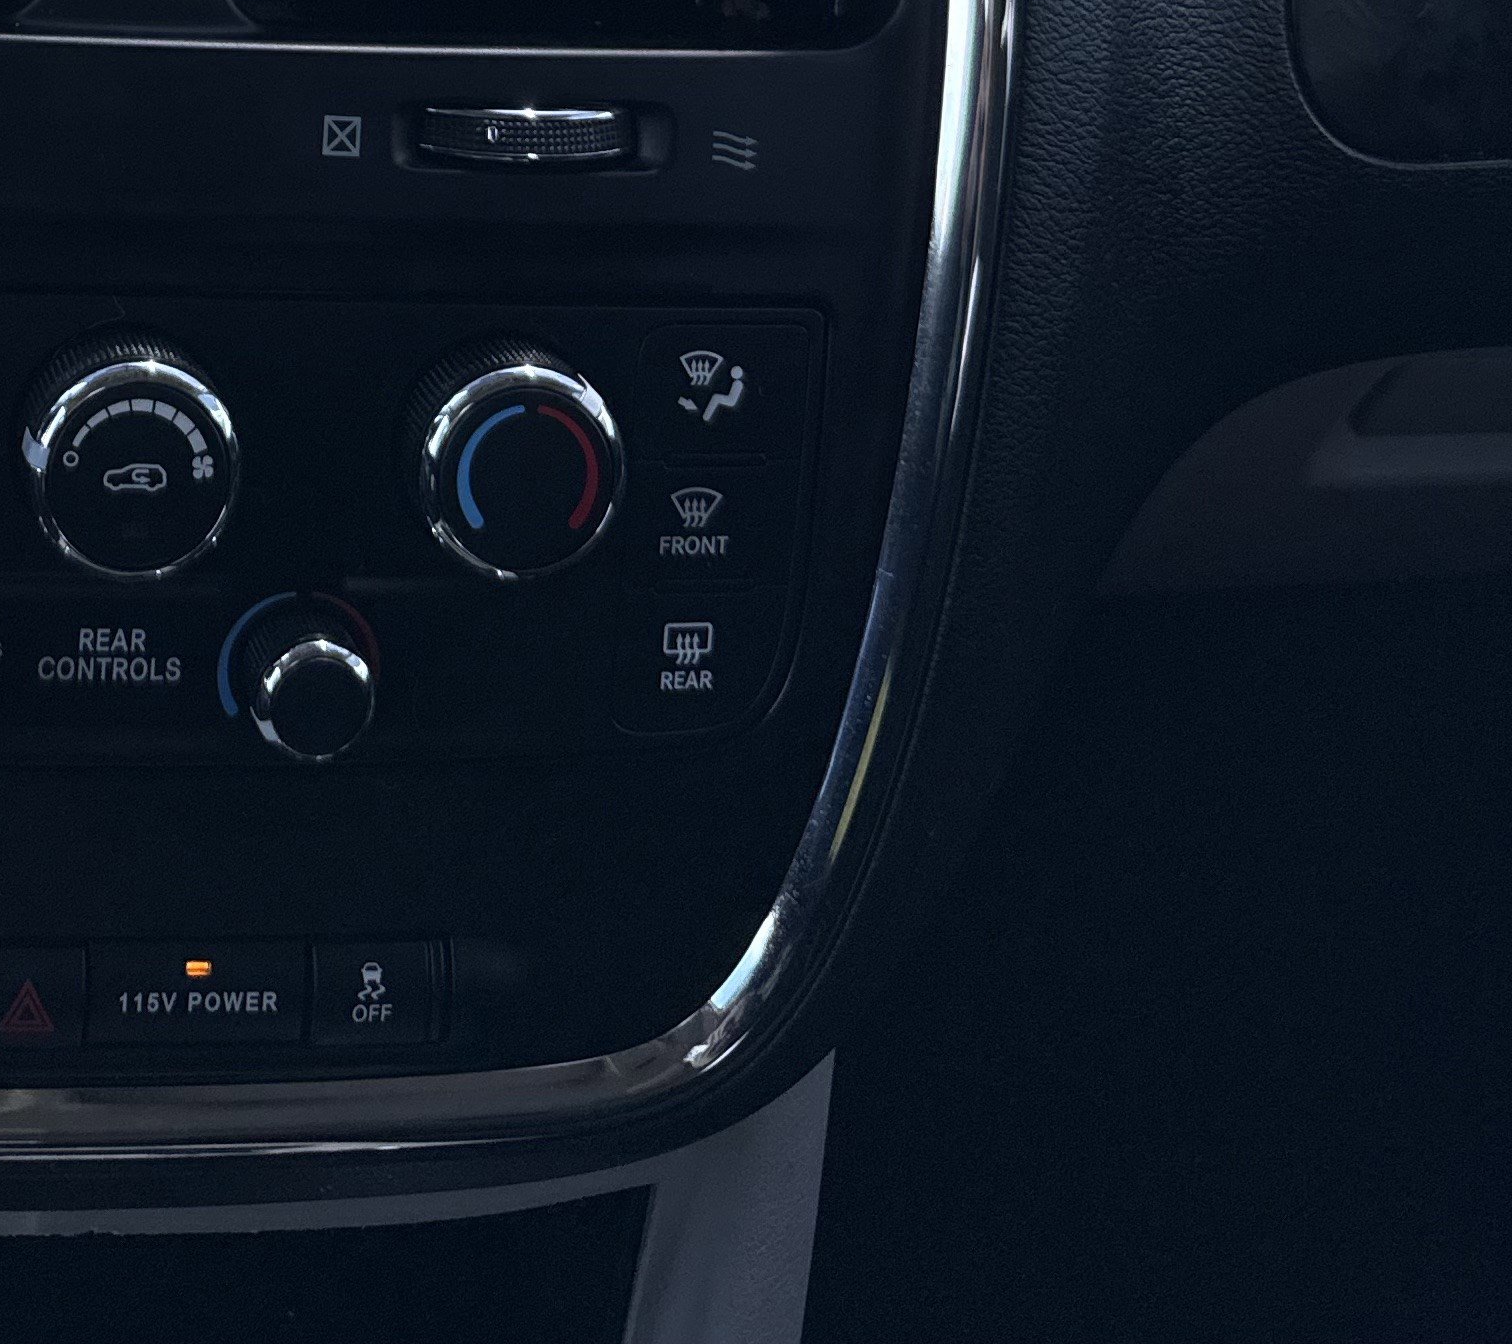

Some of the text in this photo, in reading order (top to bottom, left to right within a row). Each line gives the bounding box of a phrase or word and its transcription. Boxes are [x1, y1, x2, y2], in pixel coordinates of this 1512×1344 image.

[659, 535, 729, 556] FRONT
[78, 627, 147, 653] REAR
[37, 656, 181, 682] CONTROLS
[660, 669, 713, 691] REAR
[119, 991, 278, 1013] 115V POWER
[351, 1003, 393, 1023] OFF
